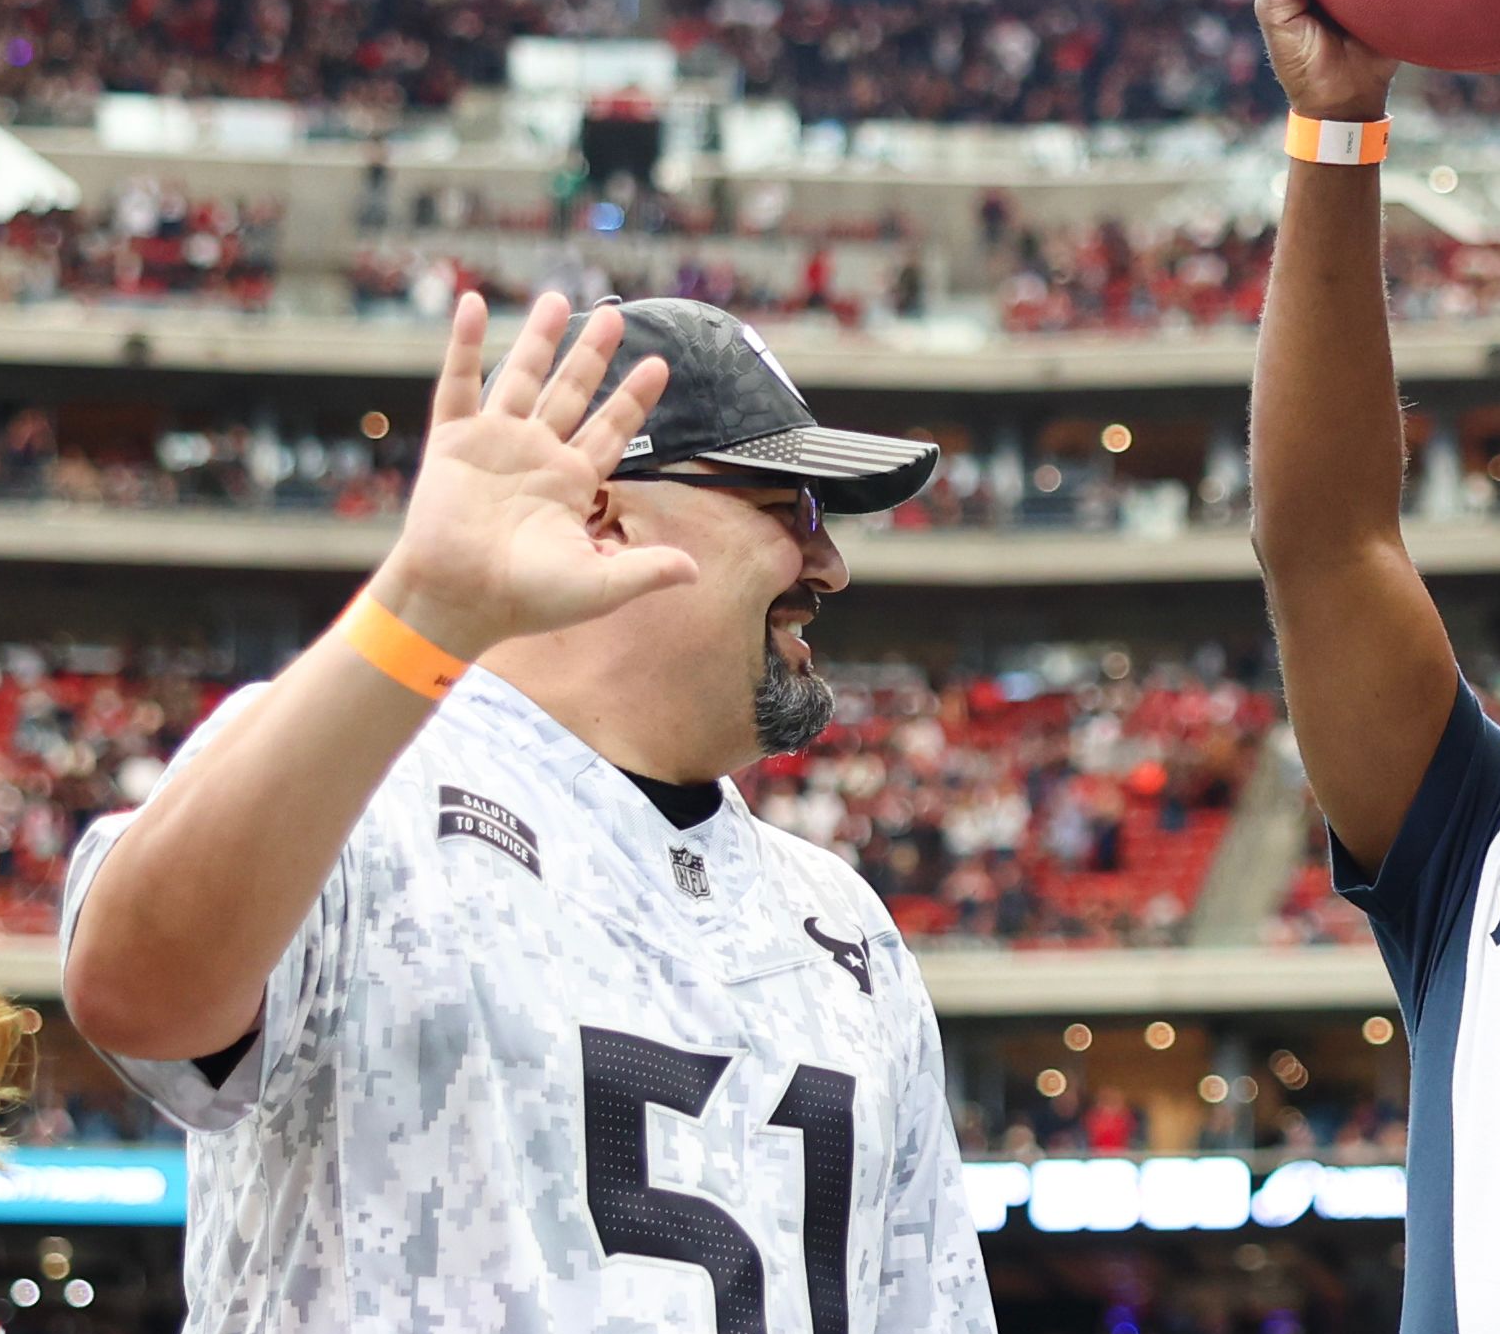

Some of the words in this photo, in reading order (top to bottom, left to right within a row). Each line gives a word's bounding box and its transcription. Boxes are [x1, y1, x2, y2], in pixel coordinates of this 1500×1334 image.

[462, 794, 518, 831] SALUTE
[455, 816, 474, 831] TO
[478, 820, 529, 864] SERVICE
[674, 864, 708, 894] NFL
